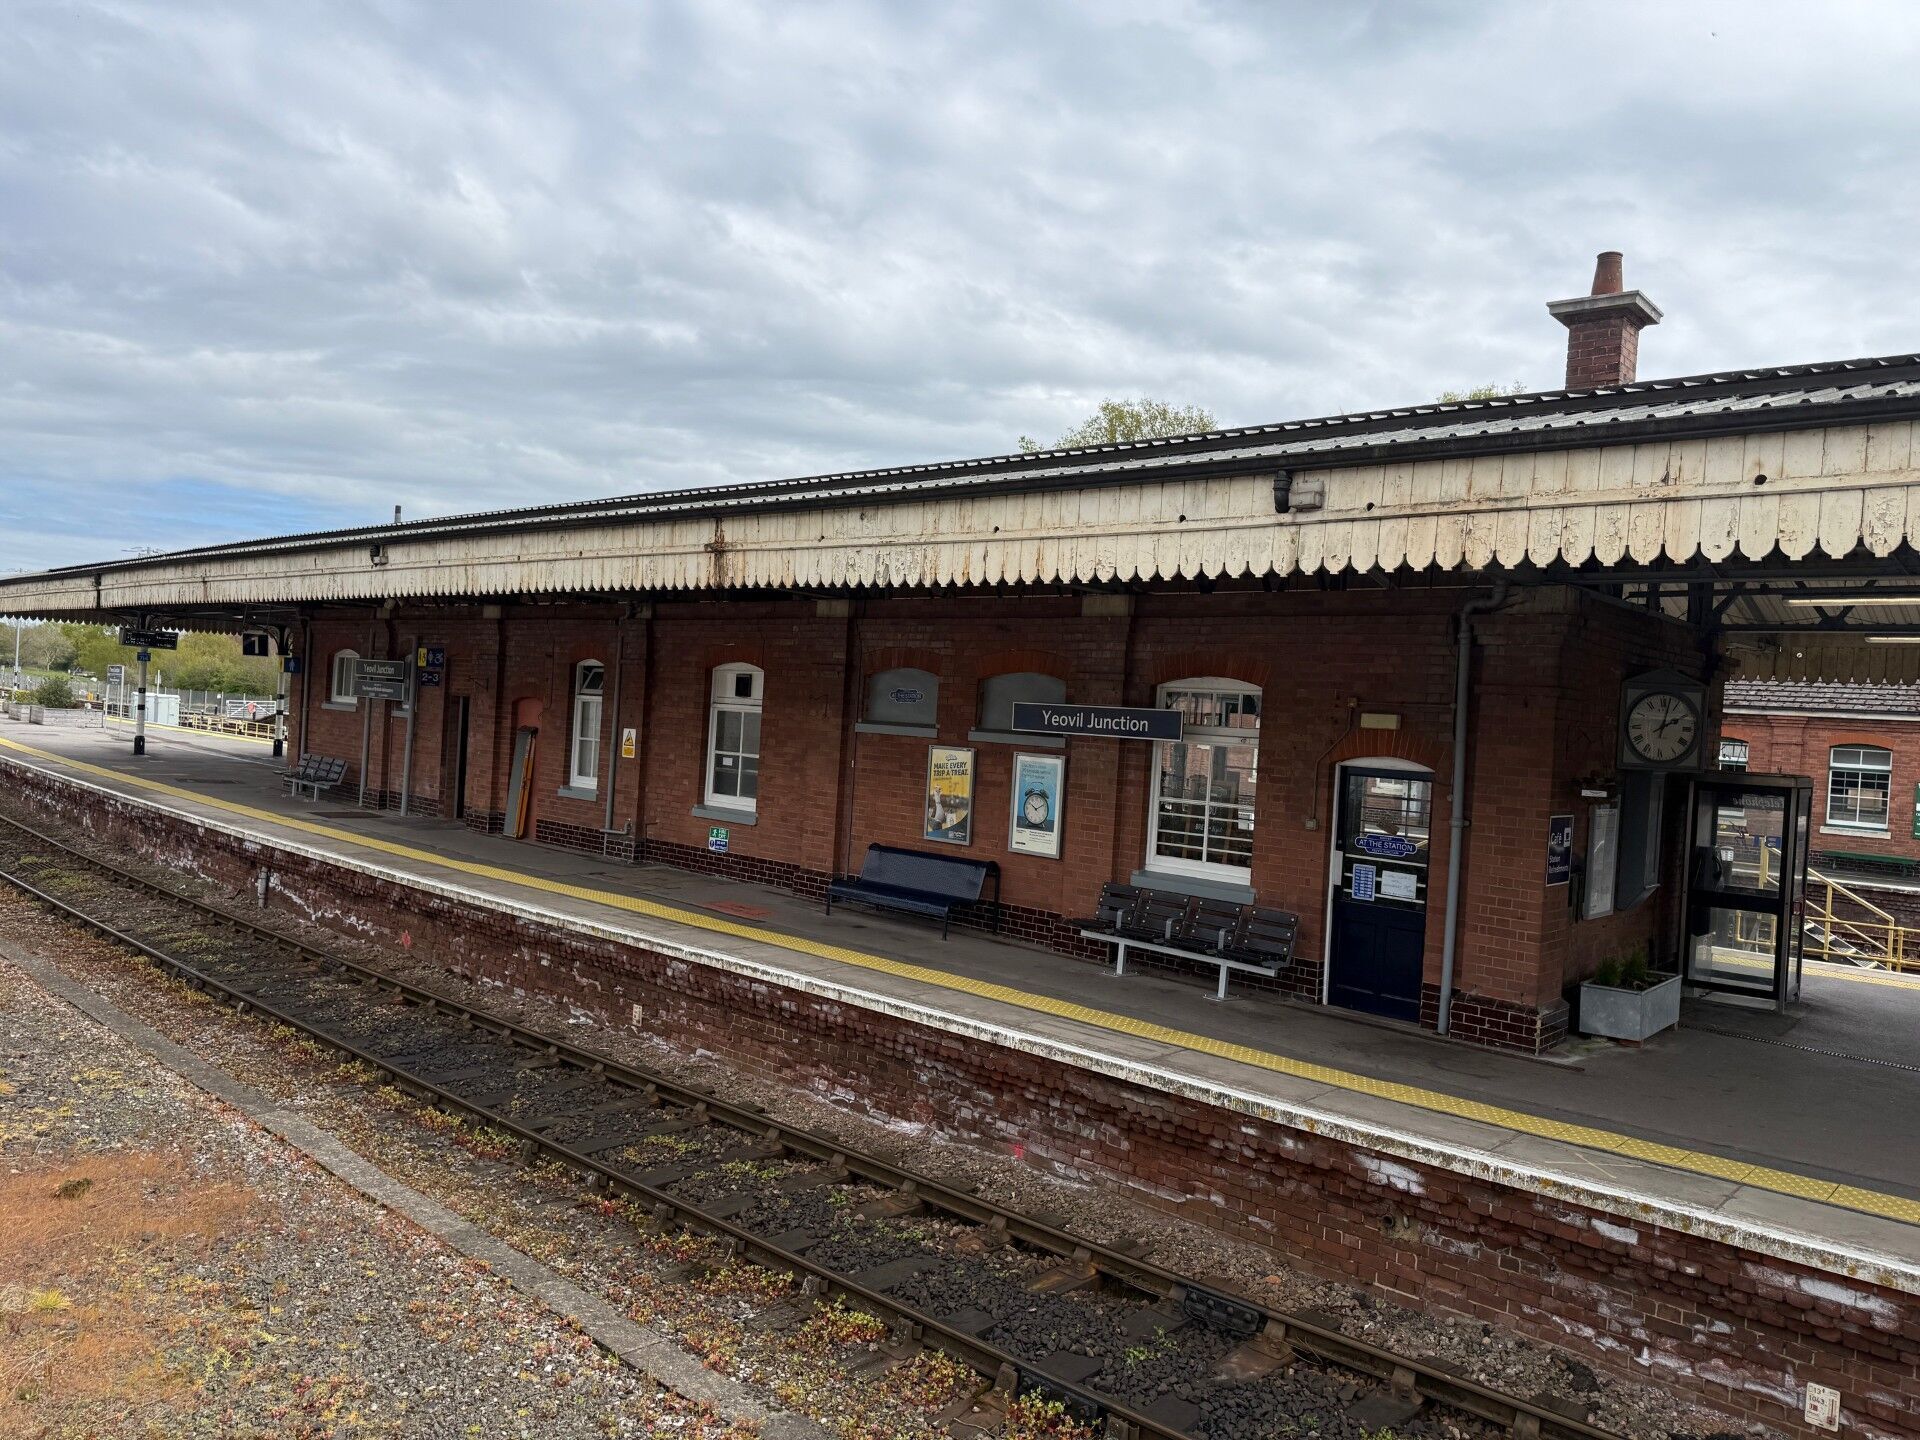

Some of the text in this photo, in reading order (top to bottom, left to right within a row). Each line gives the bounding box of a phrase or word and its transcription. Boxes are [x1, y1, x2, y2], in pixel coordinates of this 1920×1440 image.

[251, 636, 259, 654] 1
[363, 663, 395, 675] Yeovil Junction
[422, 673, 439, 682] 2-3
[1042, 710, 1149, 732] Yeovil Junction
[1551, 832, 1562, 845] Café
[1369, 840, 1383, 848] THE
[1384, 842, 1413, 851] STATION
